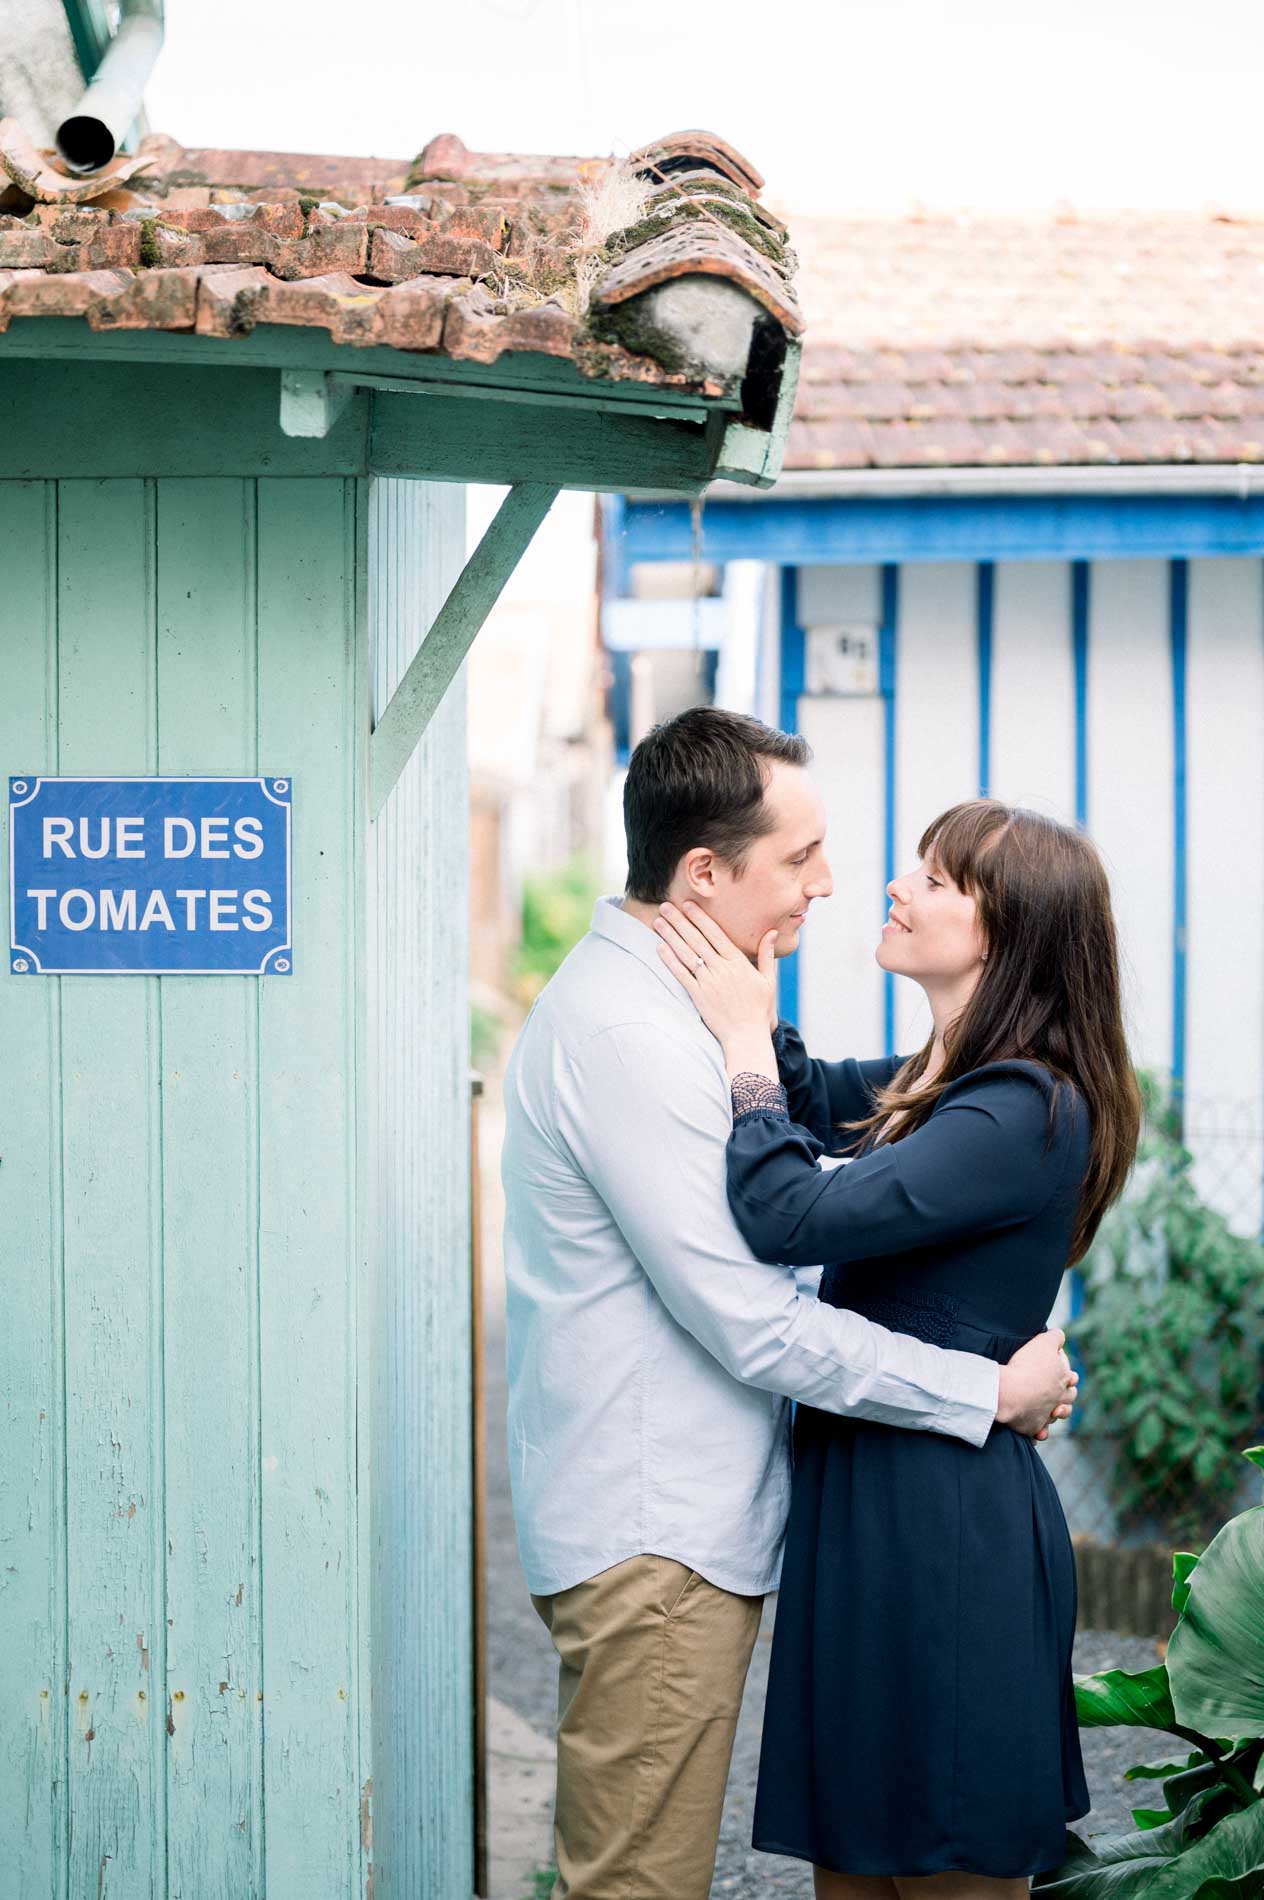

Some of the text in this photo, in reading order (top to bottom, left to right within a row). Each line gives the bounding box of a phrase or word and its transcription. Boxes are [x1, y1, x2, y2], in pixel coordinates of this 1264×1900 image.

[42, 816, 264, 860] RUE DES
[27, 889, 273, 932] TOMATES
